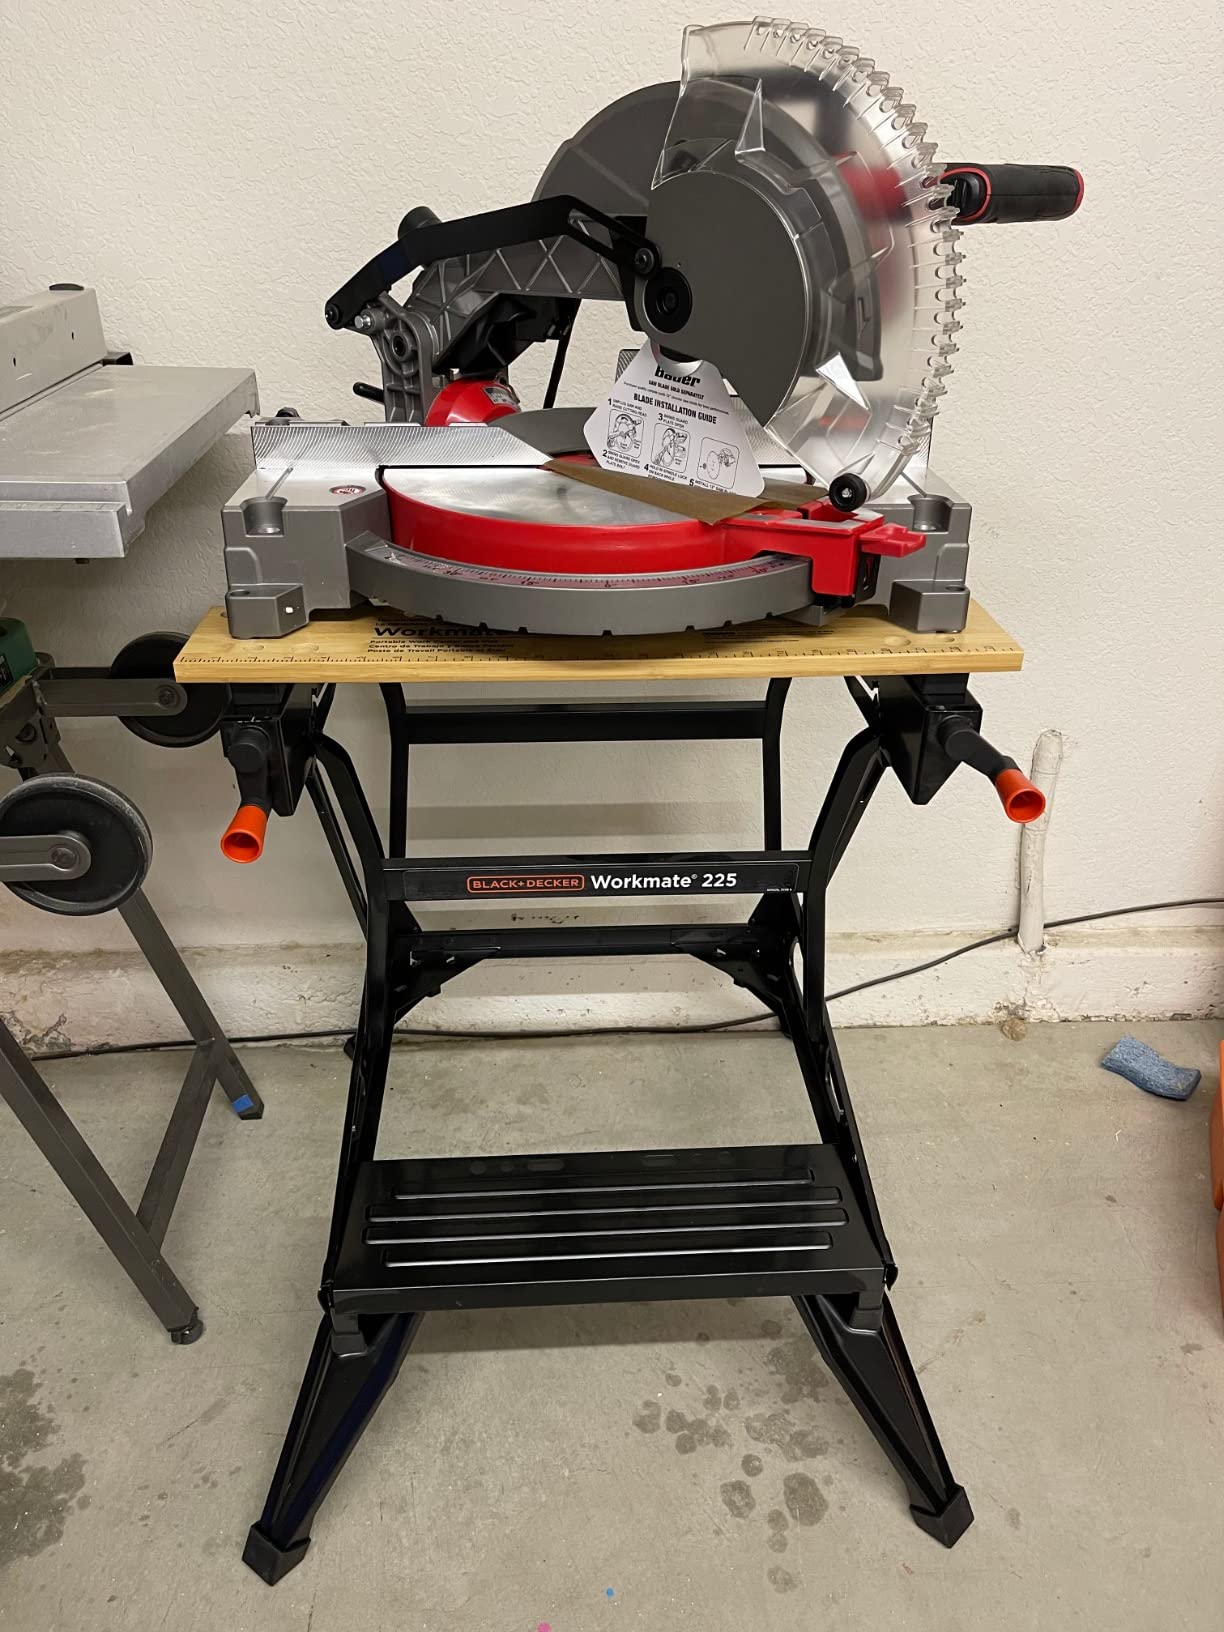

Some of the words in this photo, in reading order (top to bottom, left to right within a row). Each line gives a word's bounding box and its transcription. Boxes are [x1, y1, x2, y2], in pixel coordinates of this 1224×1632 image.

[607, 398, 612, 406] 1
[633, 393, 654, 406] BLADE
[654, 399, 697, 419] INSTALLATION
[697, 411, 718, 425] GUIDE
[657, 412, 663, 421] 3
[602, 449, 608, 458] 2
[643, 463, 650, 471] 4
[689, 478, 695, 487] 5
[472, 878, 580, 889] BLACK+DECKER
[701, 873, 738, 888] 225
